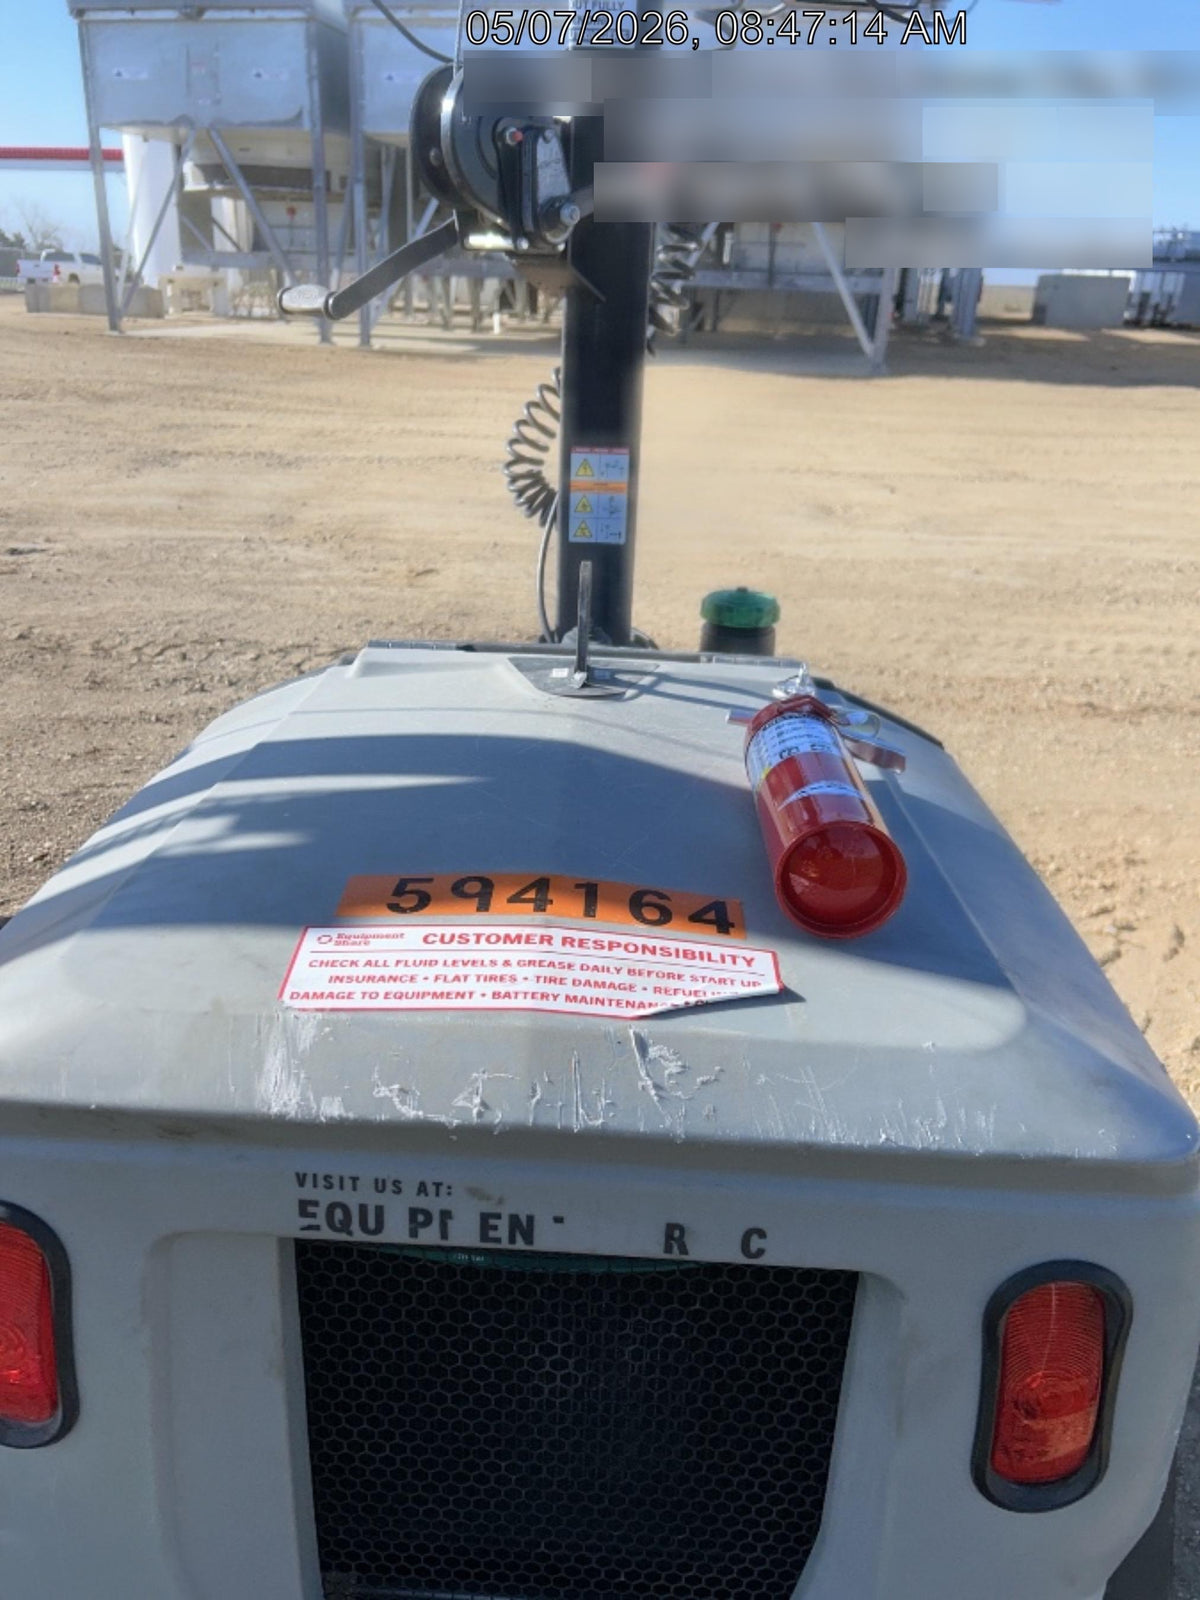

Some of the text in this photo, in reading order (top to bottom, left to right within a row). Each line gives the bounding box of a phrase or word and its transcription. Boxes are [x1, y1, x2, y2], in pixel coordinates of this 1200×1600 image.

[386, 876, 735, 935] 594164
[422, 932, 756, 968] CUSTOMER RESPONSIBILITY
[309, 959, 359, 968] CHECK
[363, 959, 390, 968] ALL
[395, 959, 438, 968] FLUID
[443, 959, 498, 969] LEVELS
[502, 960, 512, 968] &
[517, 959, 576, 972] GREASE
[580, 963, 623, 976] DAILY
[627, 968, 685, 983] BEFORE
[690, 974, 736, 987] START
[328, 974, 418, 983] INSURANCE
[434, 974, 469, 983] FLAT
[476, 974, 518, 983] TIRES
[534, 975, 568, 986] TIRE
[572, 978, 637, 994] DAMAGE
[289, 990, 356, 1000] DAMAGE
[361, 990, 379, 1000] TO
[383, 990, 474, 1000] EQUIPMENT
[491, 991, 560, 1002] BATTERY
[294, 1172, 453, 1198] VISIT US AT:
